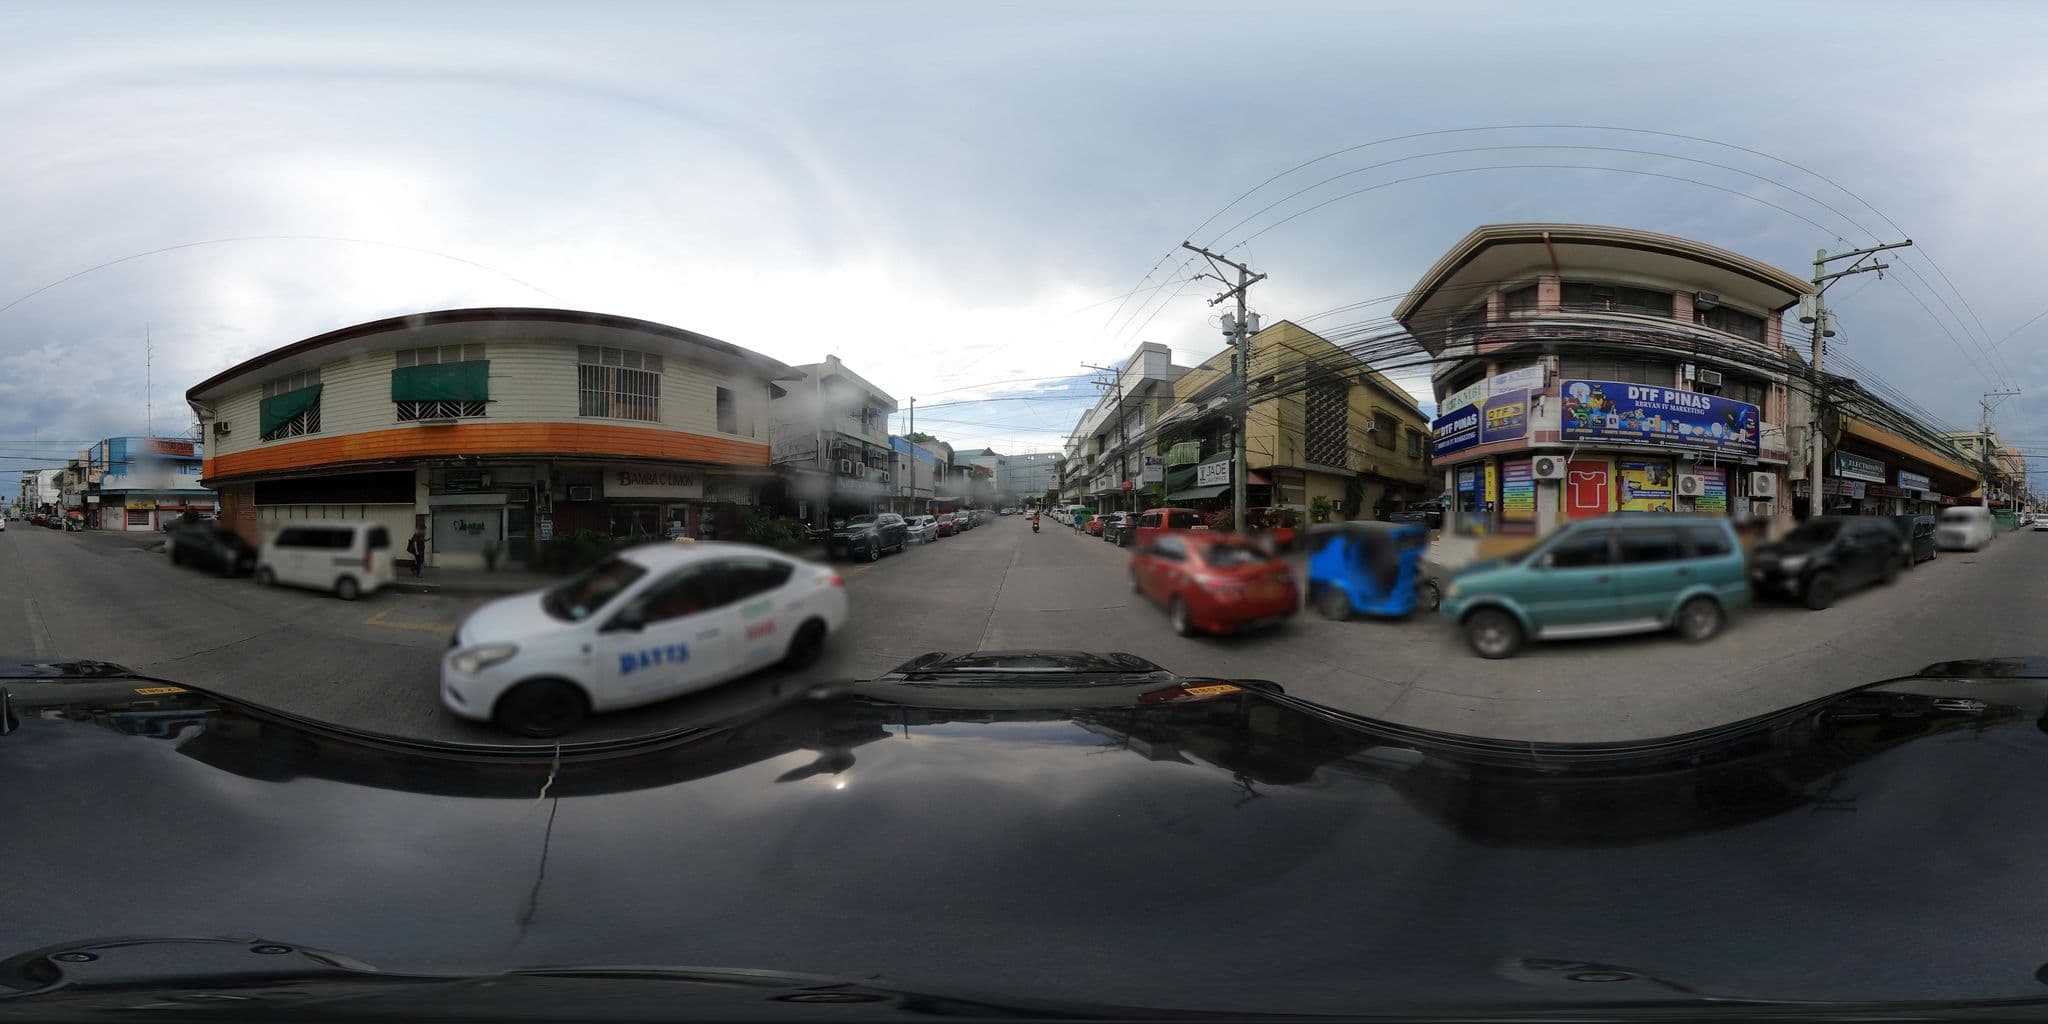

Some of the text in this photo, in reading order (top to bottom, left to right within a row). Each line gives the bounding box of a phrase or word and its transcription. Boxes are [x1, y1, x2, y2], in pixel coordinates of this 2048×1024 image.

[1628, 386, 1711, 410] DTF PINAS
[1670, 404, 1705, 415] MARKETING
[1440, 413, 1477, 437] DTF PINAS
[1206, 463, 1227, 476] JADE
